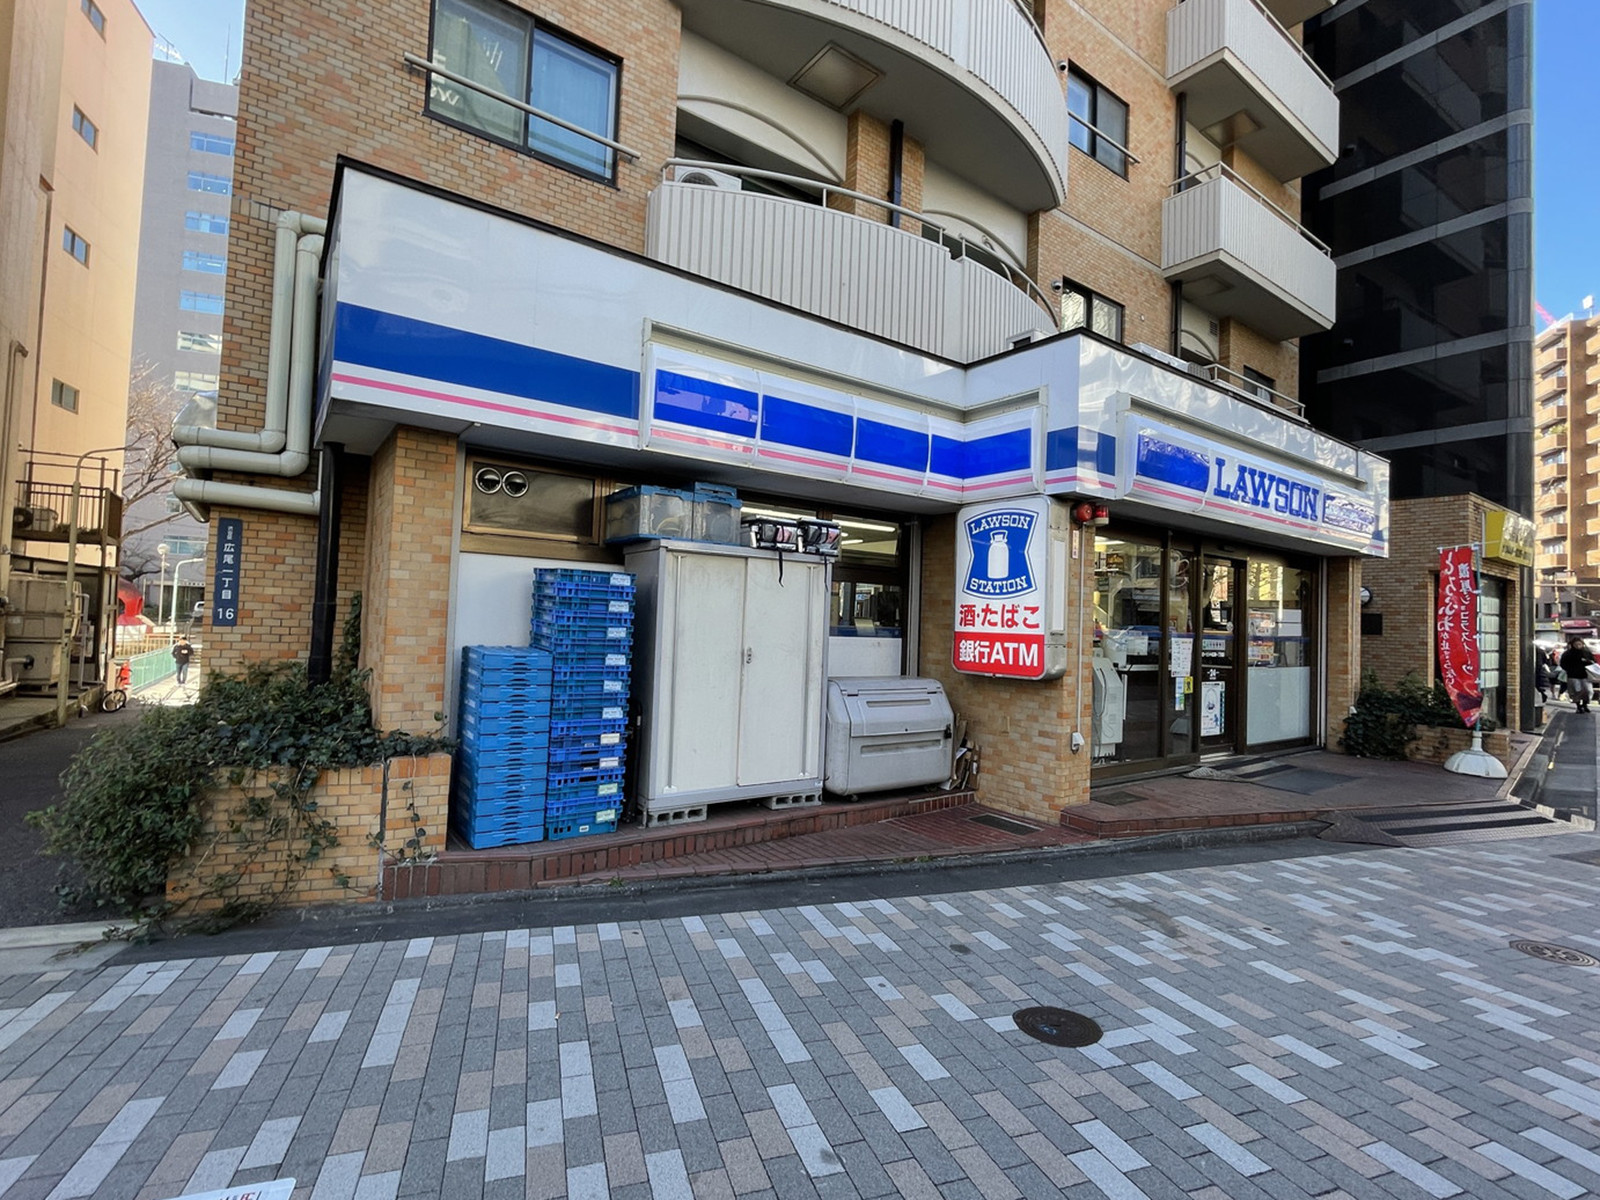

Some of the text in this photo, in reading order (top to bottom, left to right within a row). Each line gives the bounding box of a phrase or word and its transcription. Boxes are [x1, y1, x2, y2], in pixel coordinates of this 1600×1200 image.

[1214, 457, 1320, 522] LAWSON
[970, 514, 1031, 535] LAWSON
[221, 543, 235, 600] 広尾一丁目
[969, 575, 1028, 593] STATION
[217, 607, 235, 620] 16
[959, 603, 1040, 629] 酒・たばこ
[959, 639, 1039, 667] 銀行ATM
